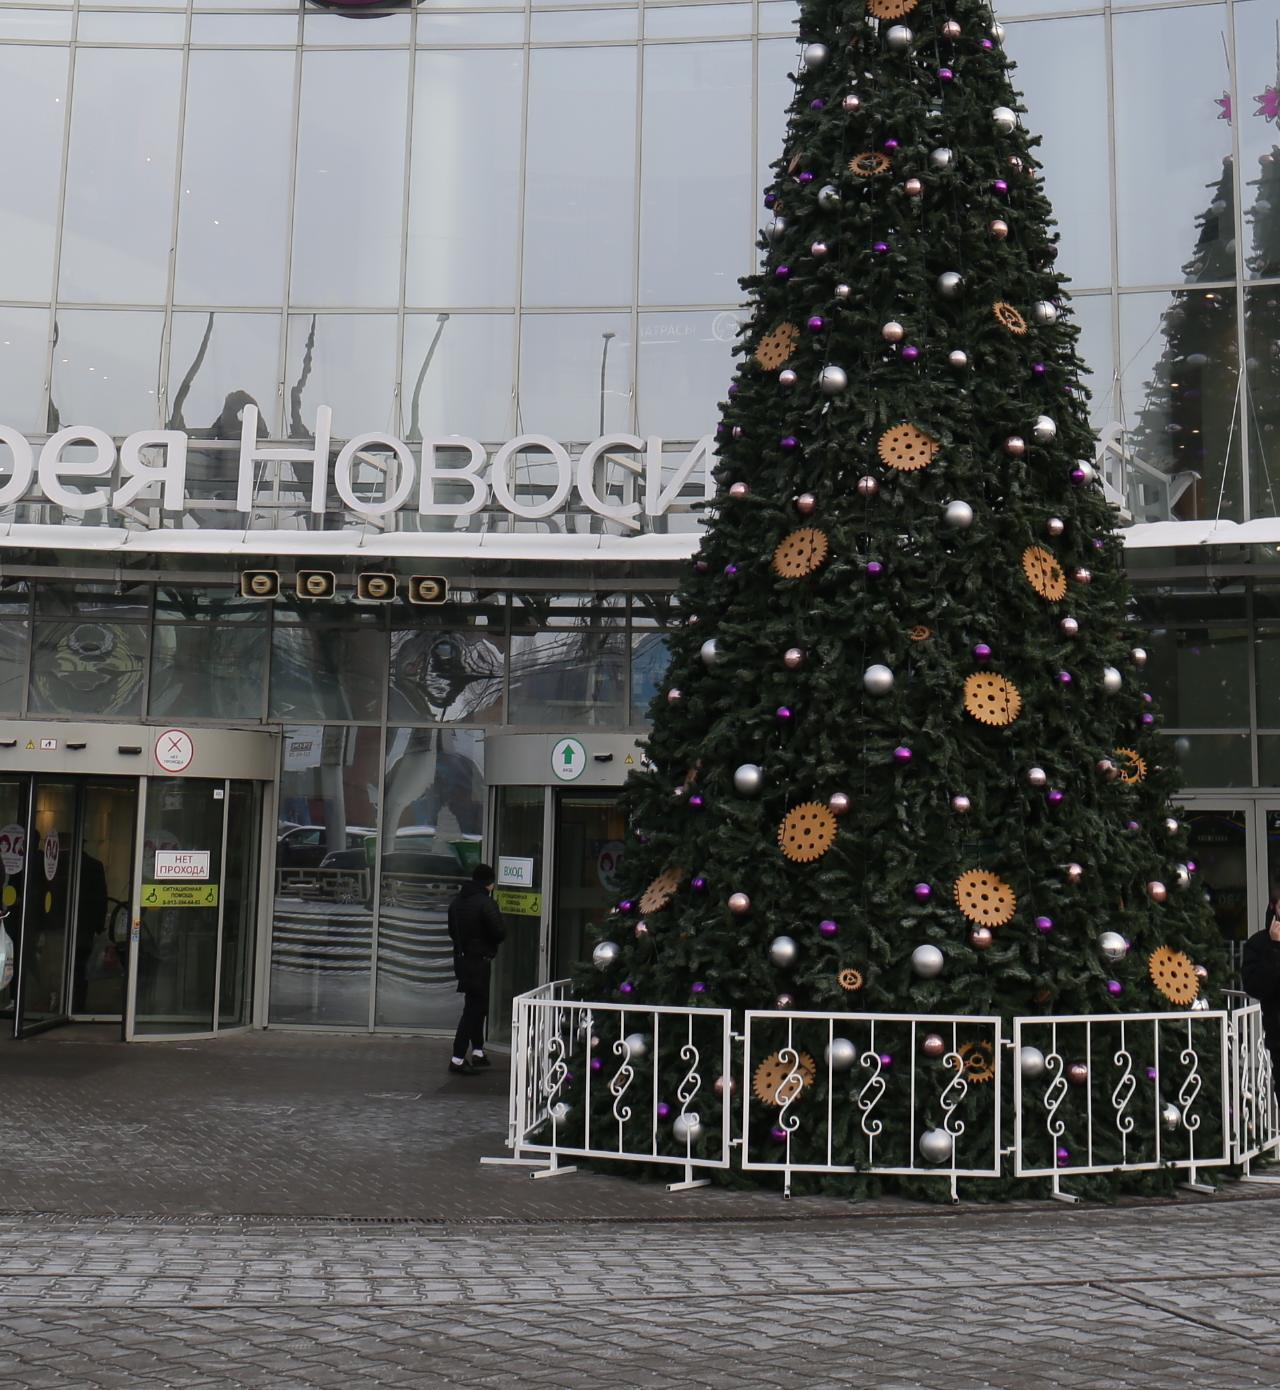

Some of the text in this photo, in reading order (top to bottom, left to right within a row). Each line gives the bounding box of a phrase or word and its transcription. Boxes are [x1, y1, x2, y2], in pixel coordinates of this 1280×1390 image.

[175, 855, 193, 864] НЕТ
[159, 866, 205, 876] ПРОХОДА
[503, 867, 524, 879] ВХОД
